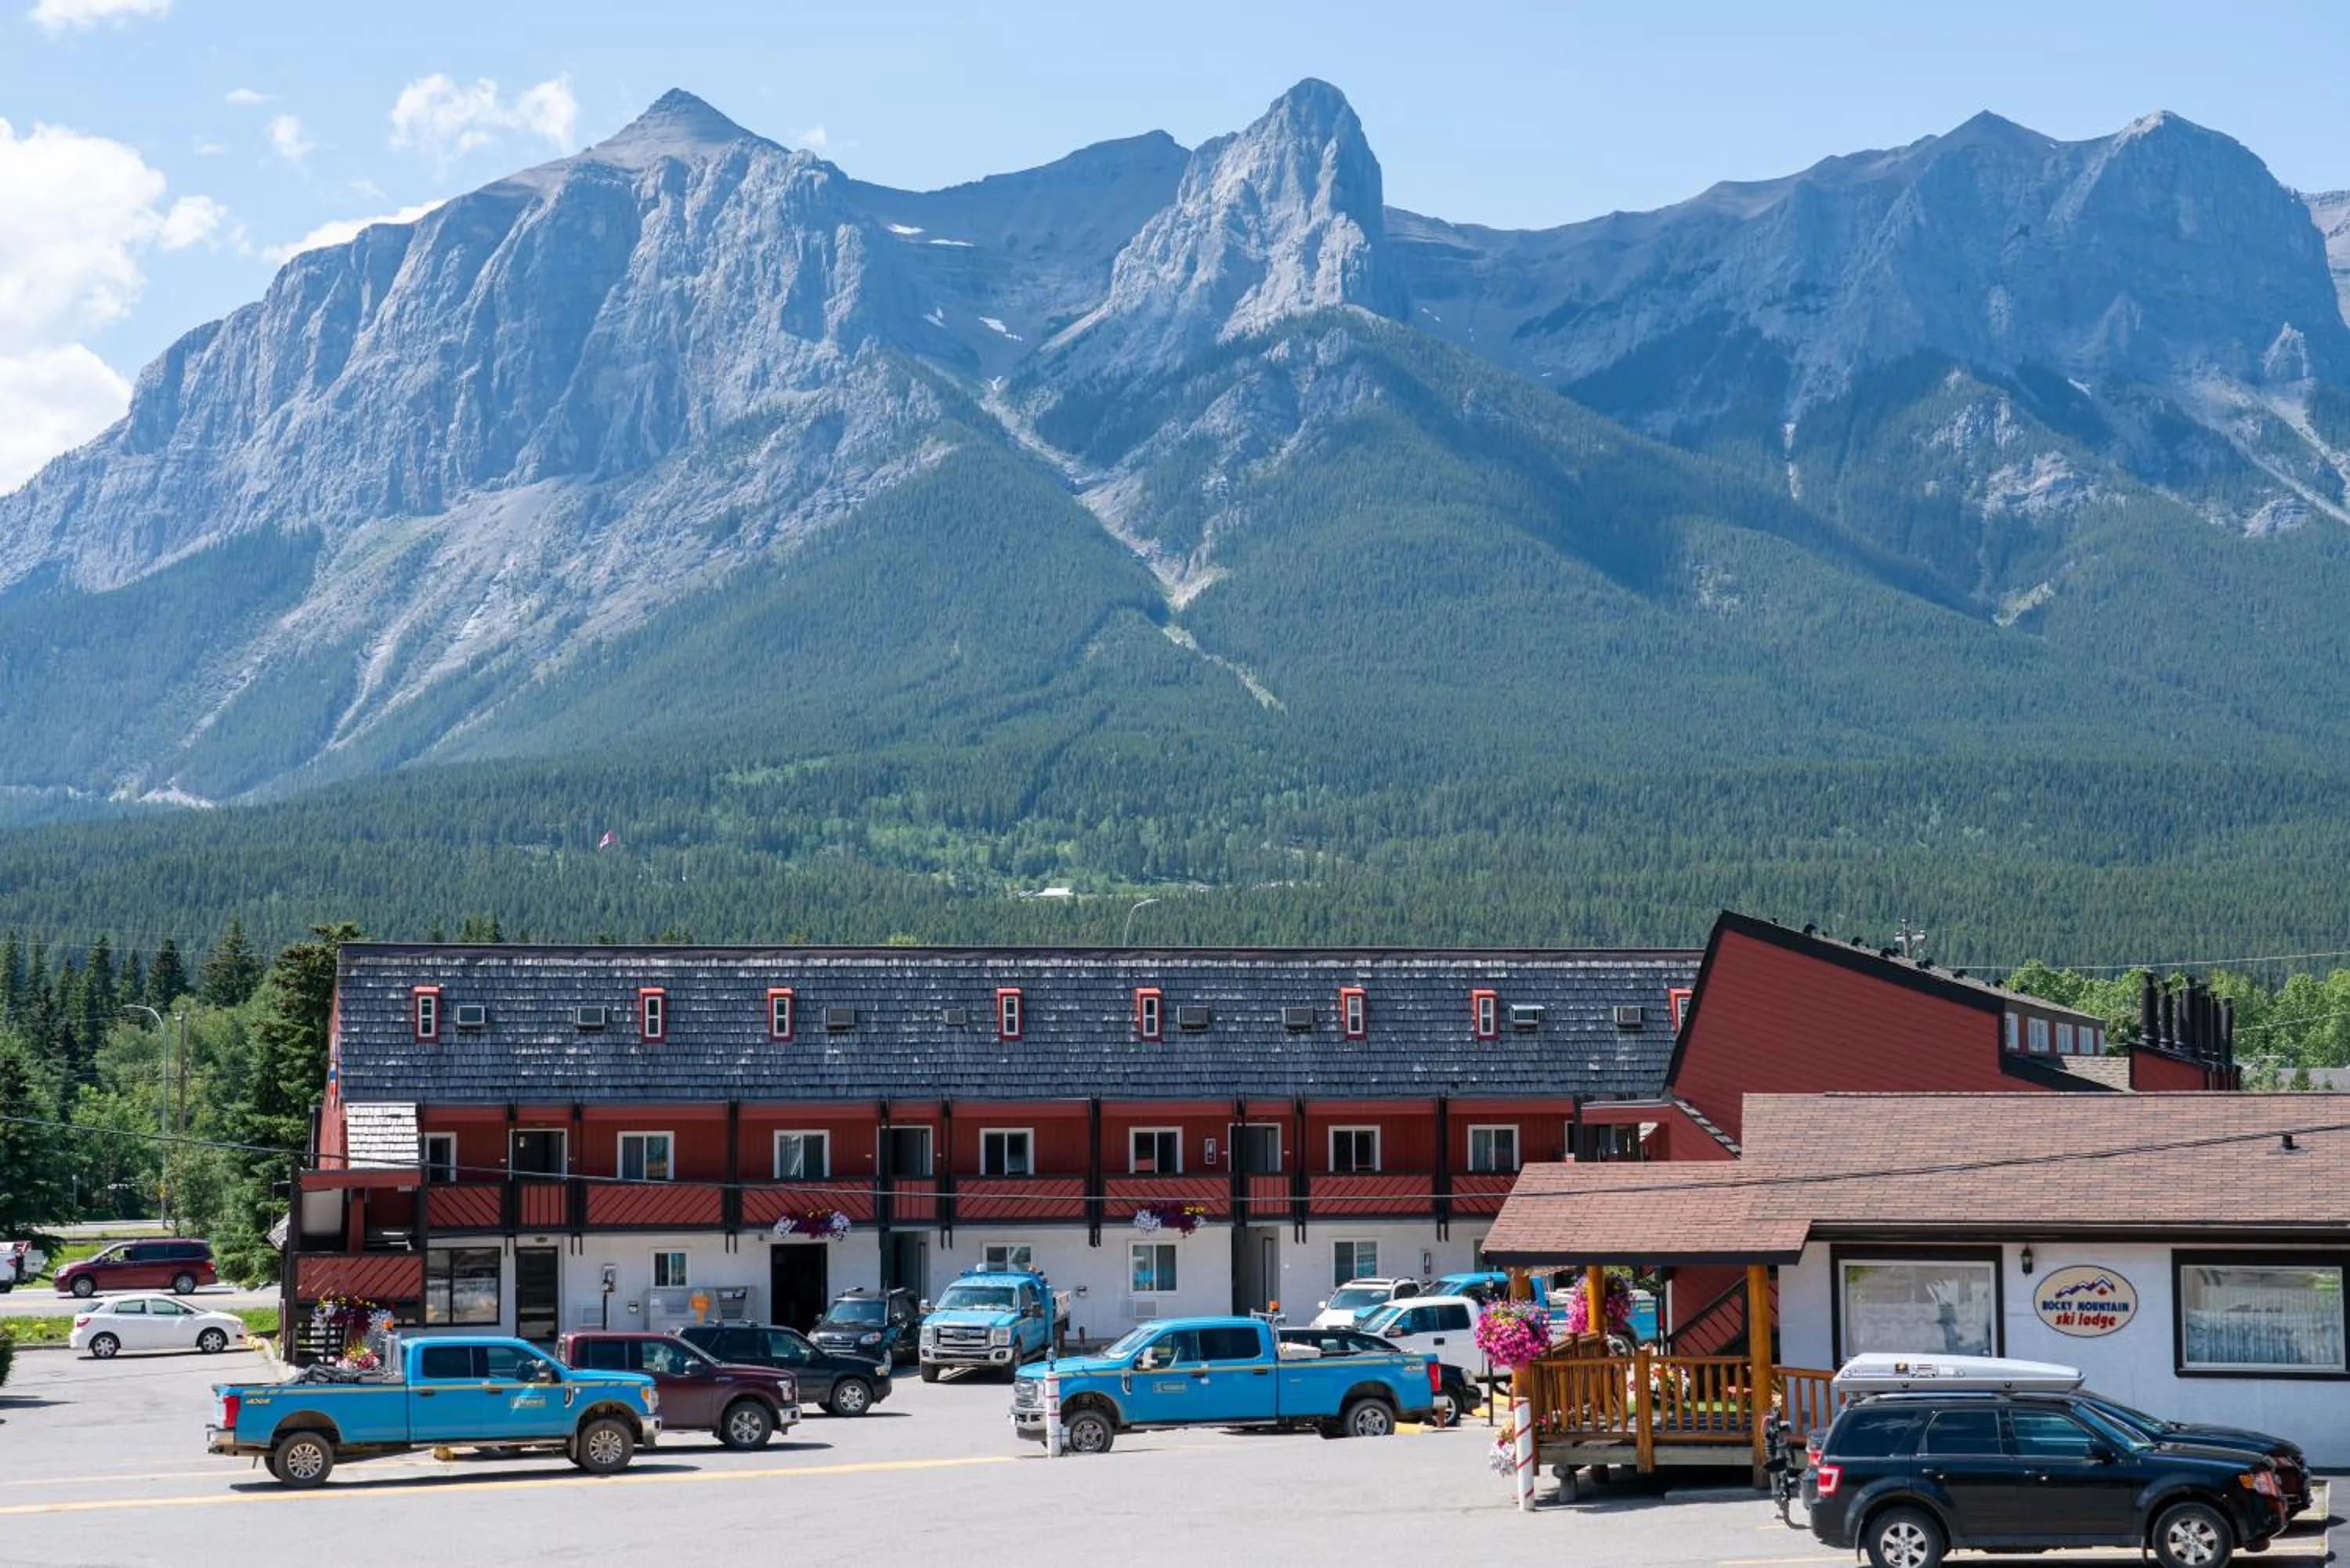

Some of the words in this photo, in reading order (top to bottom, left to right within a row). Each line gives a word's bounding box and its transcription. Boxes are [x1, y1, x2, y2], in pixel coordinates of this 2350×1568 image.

[2042, 1301, 2072, 1310] ROCKY
[2077, 1302, 2129, 1312] MOUNTAIN
[2055, 1312, 2075, 1325] ski
[2078, 1312, 2117, 1328] lodge
